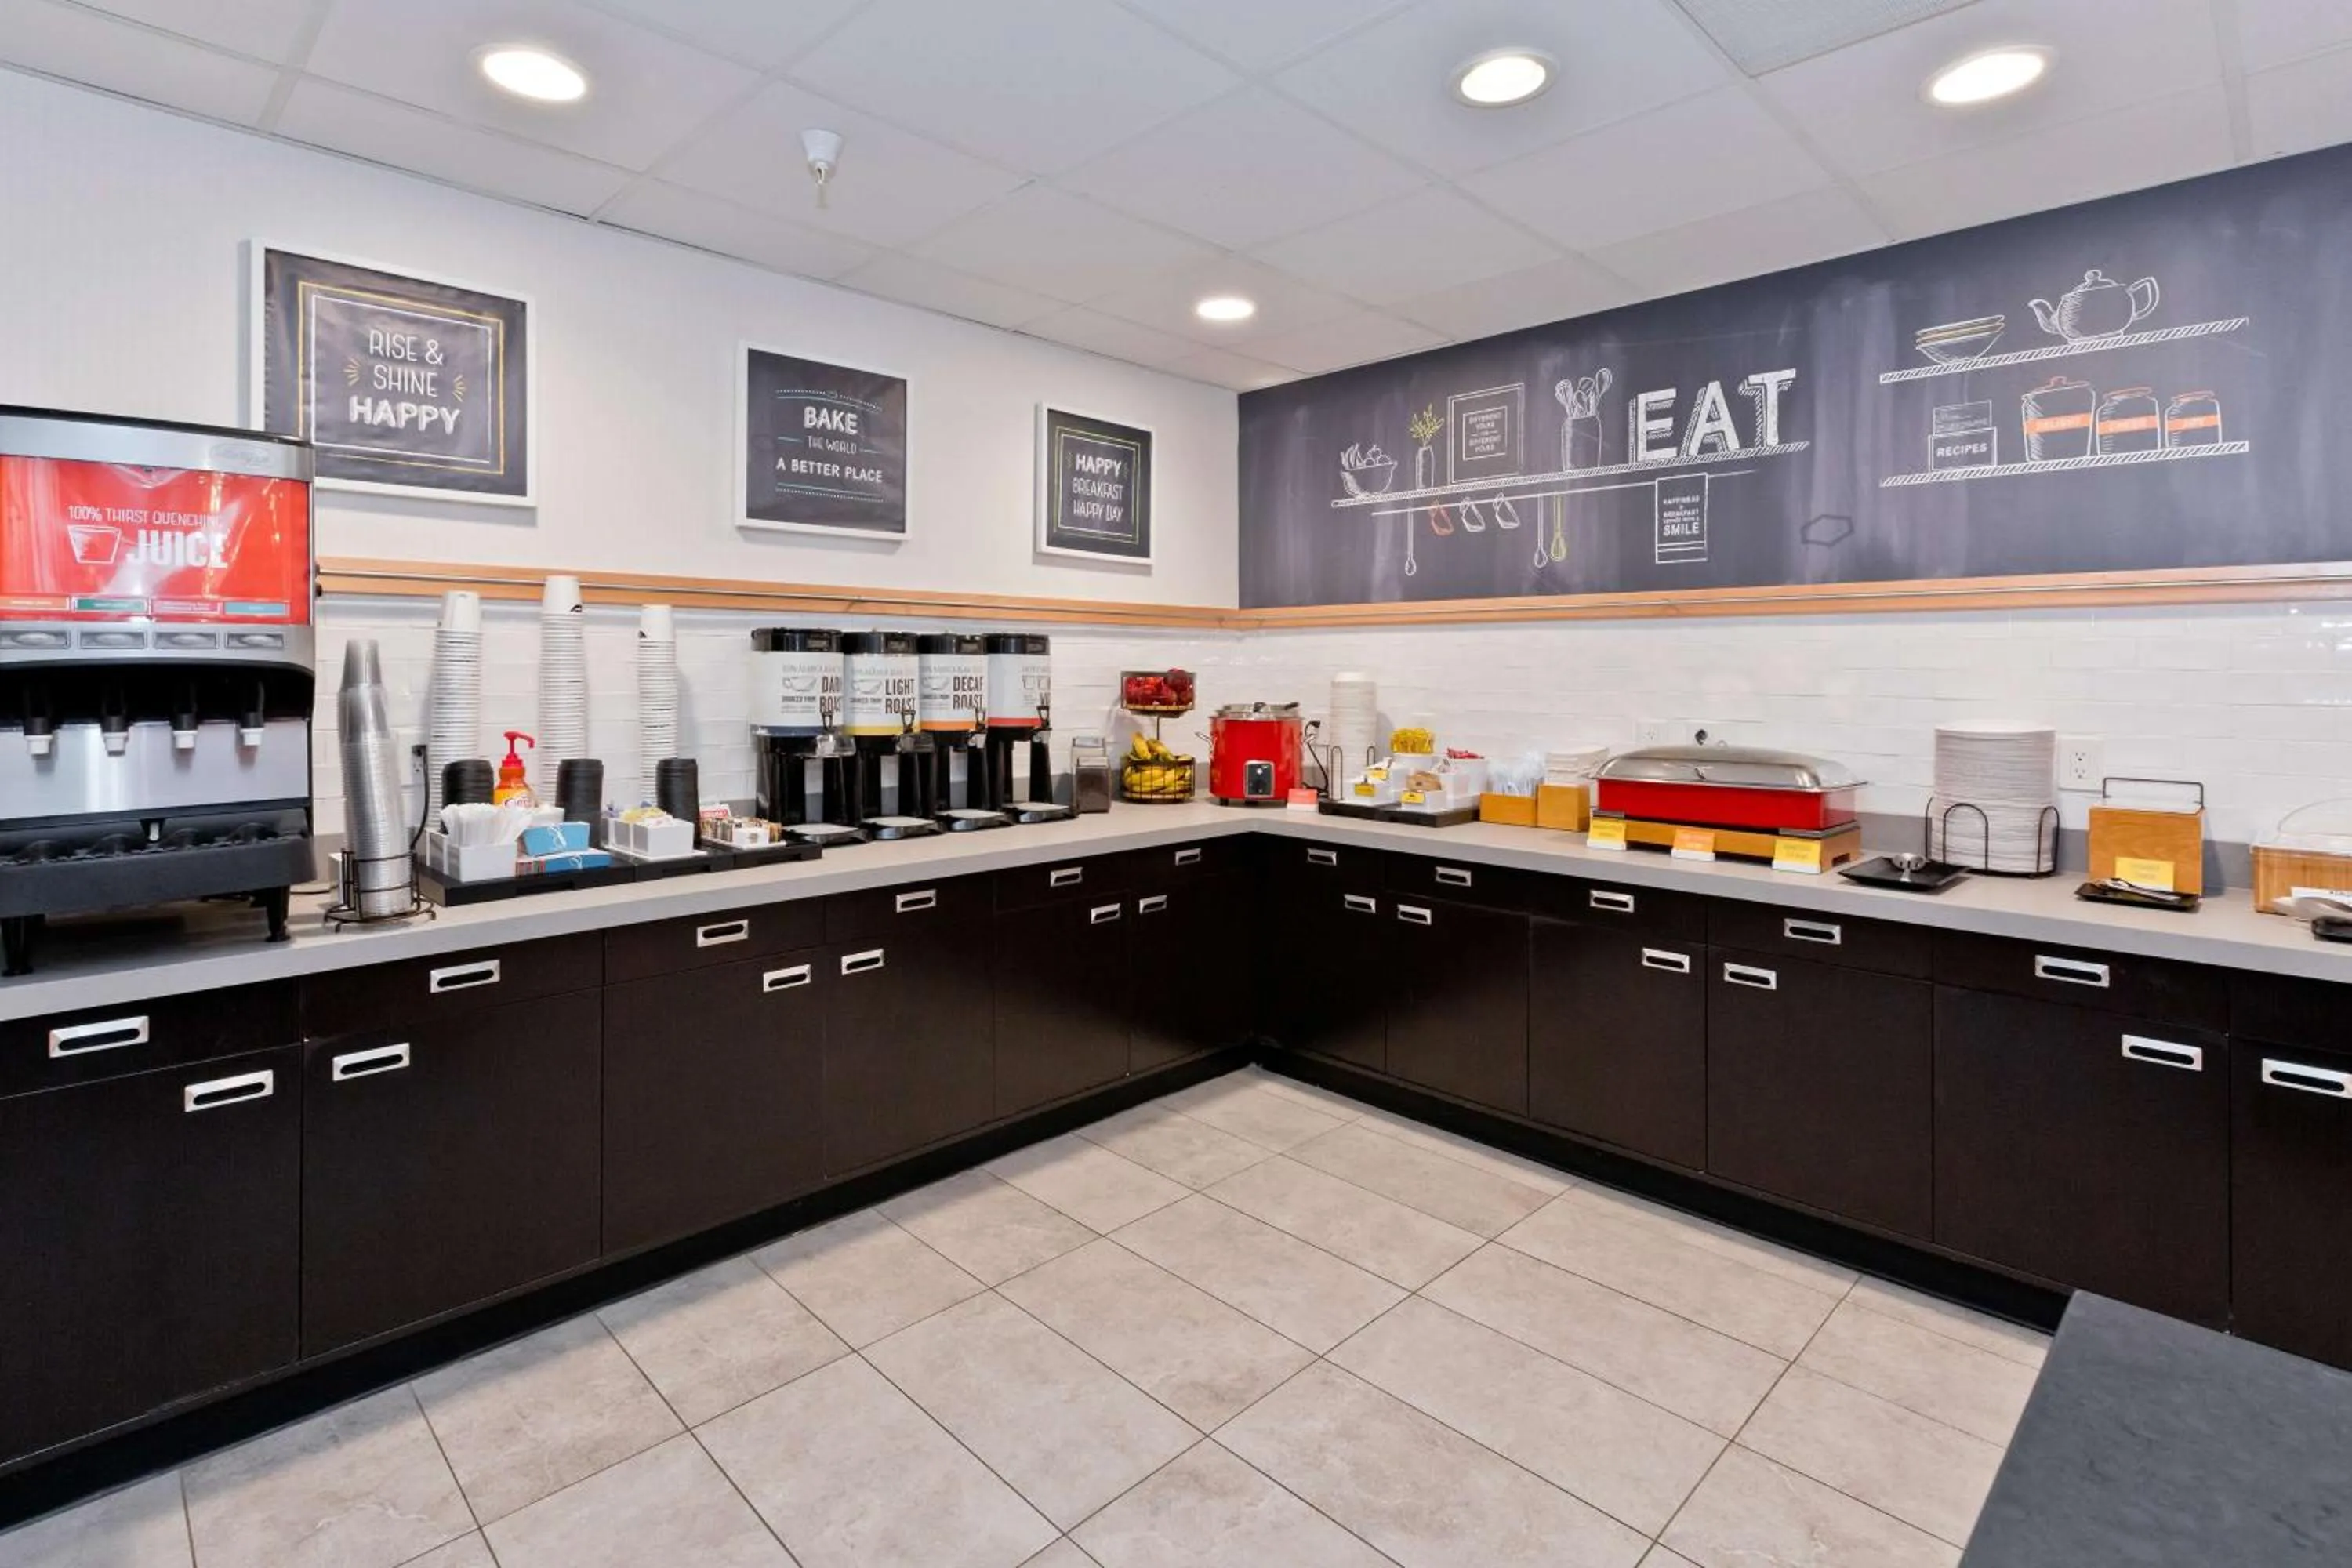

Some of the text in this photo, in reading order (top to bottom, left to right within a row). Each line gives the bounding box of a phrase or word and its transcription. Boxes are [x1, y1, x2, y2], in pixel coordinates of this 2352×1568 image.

[369, 330, 444, 365] RISE &
[372, 365, 439, 398] SHINE
[348, 395, 461, 435] HAPPY
[804, 406, 858, 434] BAKE
[1629, 368, 1796, 463] EAT
[808, 436, 857, 455] THE WORLD
[1936, 442, 1987, 457] RECIPES
[776, 457, 883, 484] A BETTER PLACE
[1075, 453, 1122, 477] HAPPY
[1072, 477, 1124, 500] BREAKFAST
[68, 505, 102, 521] 100%
[1073, 499, 1123, 522] HAPPY DAY
[1663, 521, 1700, 537] SMILE
[126, 529, 228, 568] JUICE
[822, 675, 843, 693] DAR
[885, 678, 914, 695] LIGHT
[953, 677, 983, 691] DECAF
[820, 695, 841, 713] ROAS
[885, 696, 916, 715] ROAST
[953, 694, 983, 710] ROAST
